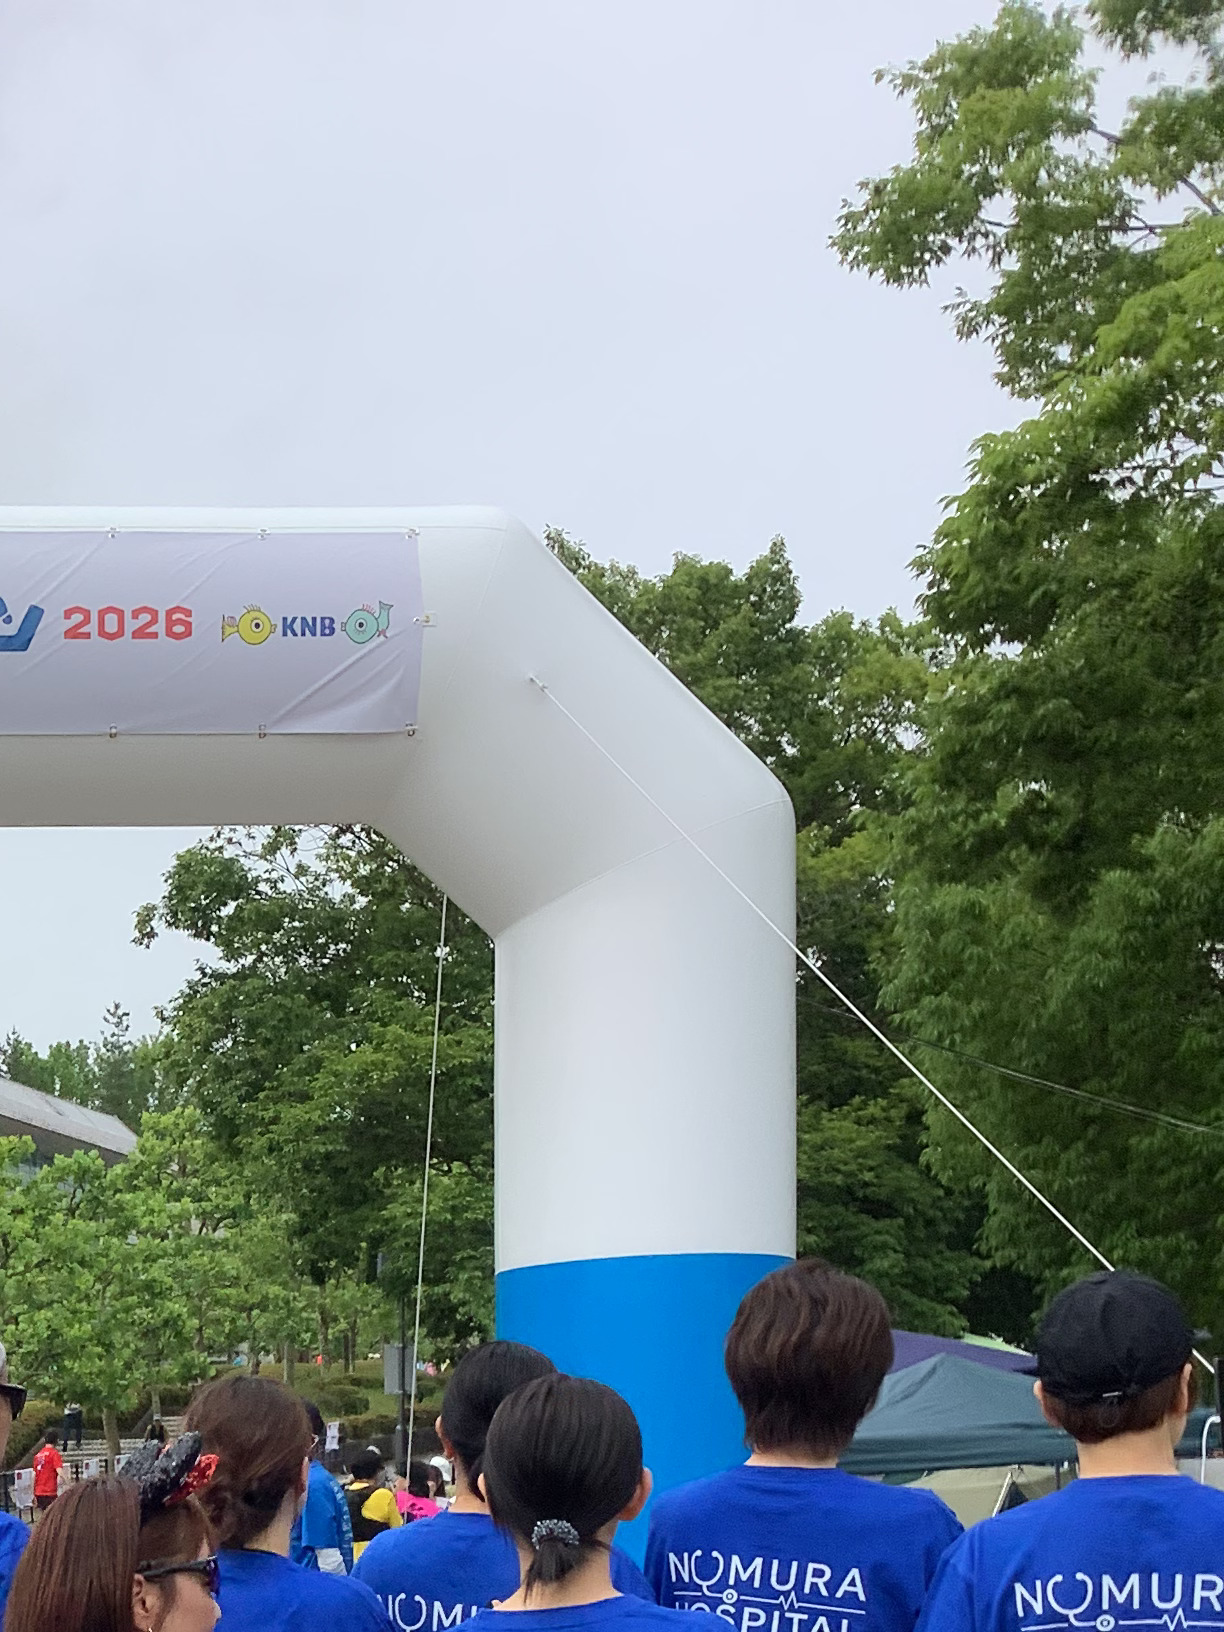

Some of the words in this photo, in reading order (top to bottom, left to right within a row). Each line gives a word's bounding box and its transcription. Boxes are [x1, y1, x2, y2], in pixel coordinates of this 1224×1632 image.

[63, 605, 193, 641] 2026
[281, 616, 336, 638] KNB
[668, 1549, 867, 1602] NOMURA
[1014, 1571, 1224, 1617] NOMUR
